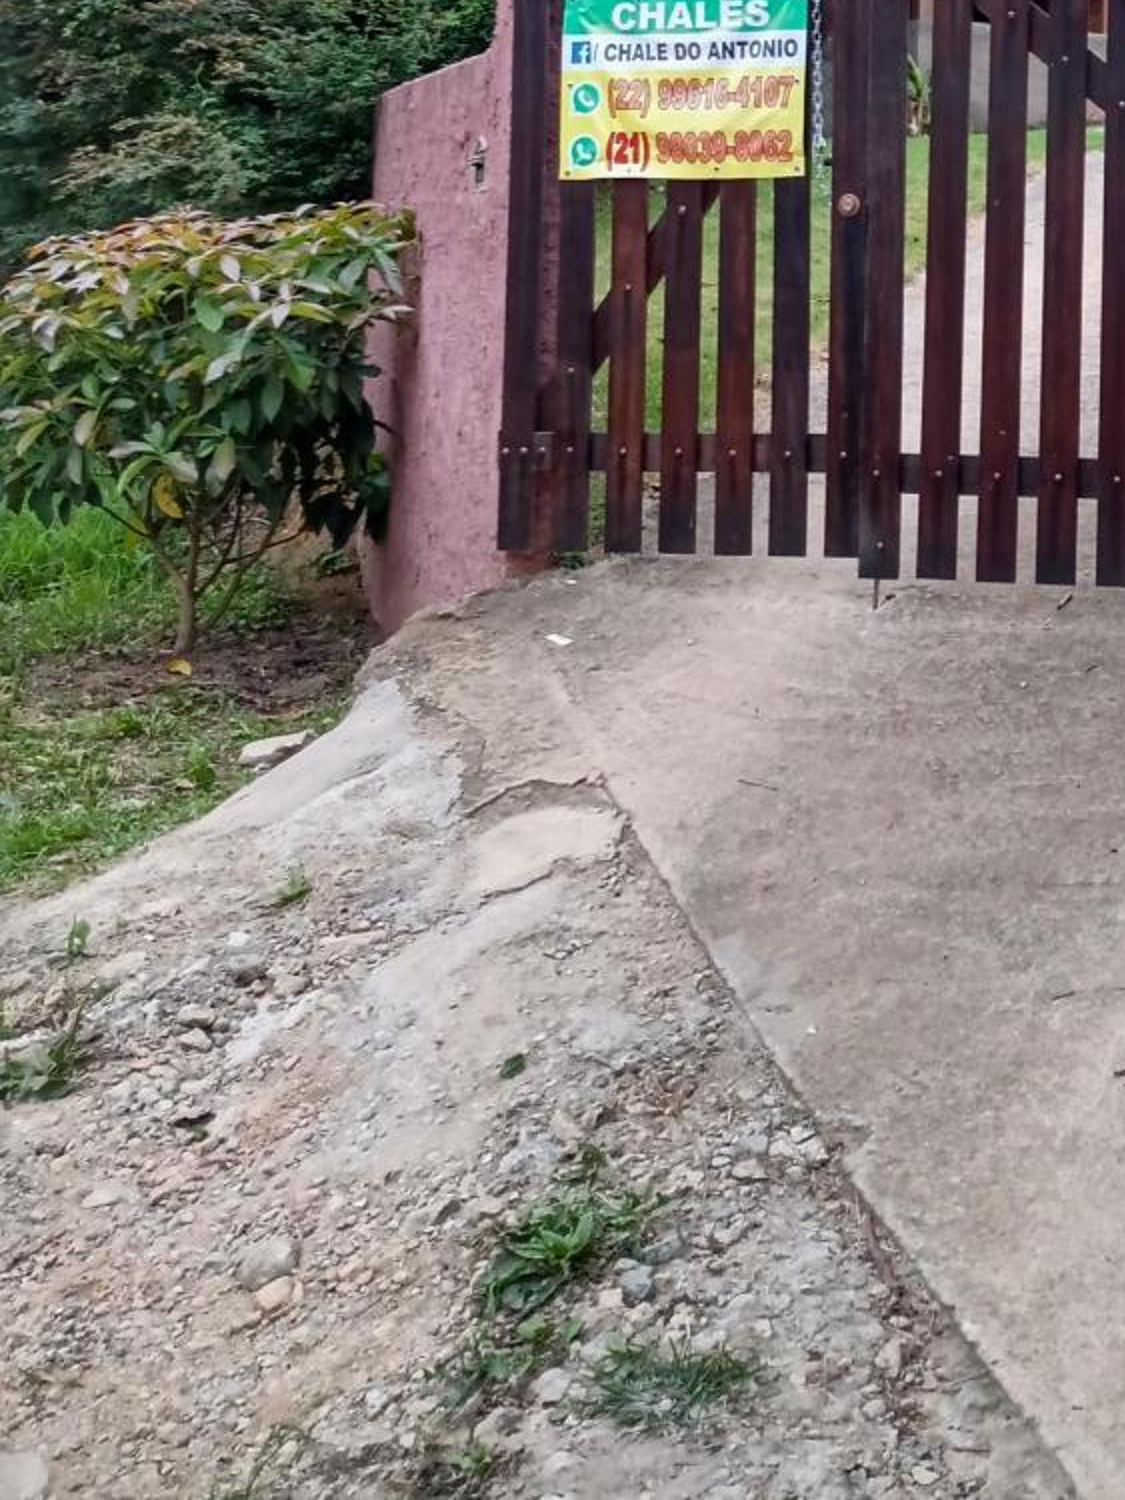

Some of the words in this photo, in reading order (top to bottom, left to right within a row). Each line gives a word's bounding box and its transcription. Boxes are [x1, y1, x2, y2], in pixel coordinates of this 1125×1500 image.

[604, 43, 668, 63] CHALE
[675, 41, 702, 61] DO
[708, 38, 799, 61] ANTONIO
[608, 78, 651, 118] (22)
[606, 131, 650, 172] (21)
